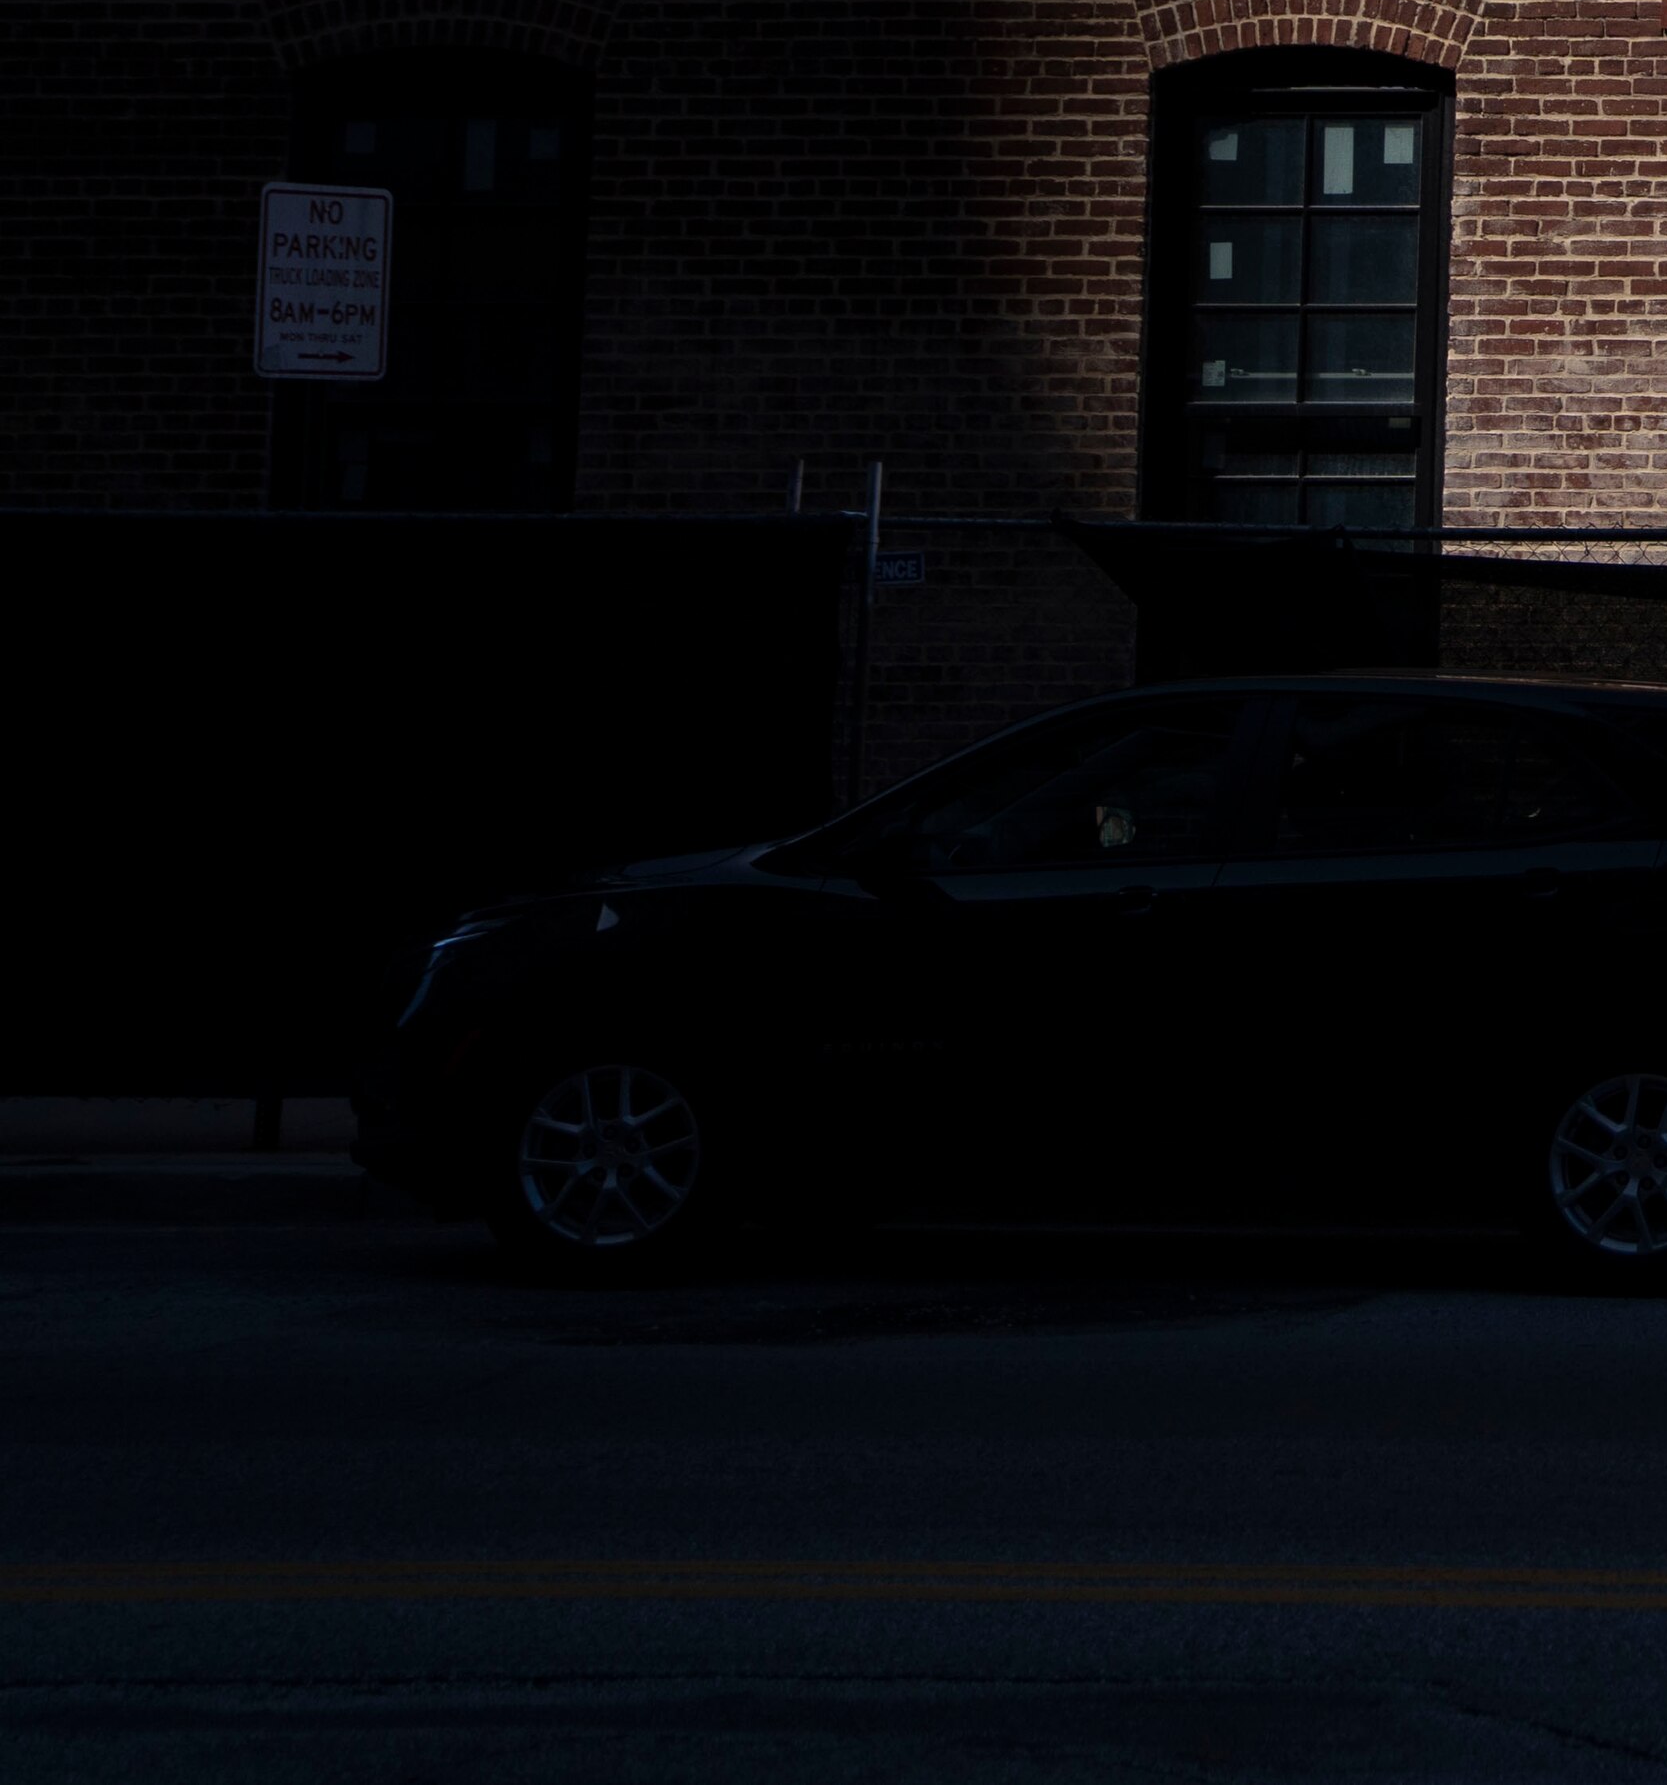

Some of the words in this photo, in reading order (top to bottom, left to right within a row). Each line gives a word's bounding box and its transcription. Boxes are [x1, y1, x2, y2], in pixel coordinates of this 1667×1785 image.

[309, 199, 344, 225] NO
[272, 232, 377, 262] PARKING
[269, 266, 302, 287] TRUCK
[305, 267, 350, 288] LOADING
[353, 269, 381, 289] ZONE
[270, 297, 376, 326] 8AM-6PM
[279, 331, 305, 342] MON
[308, 332, 337, 344] THRU
[341, 333, 363, 345] SAT
[874, 558, 919, 580] ENCE
